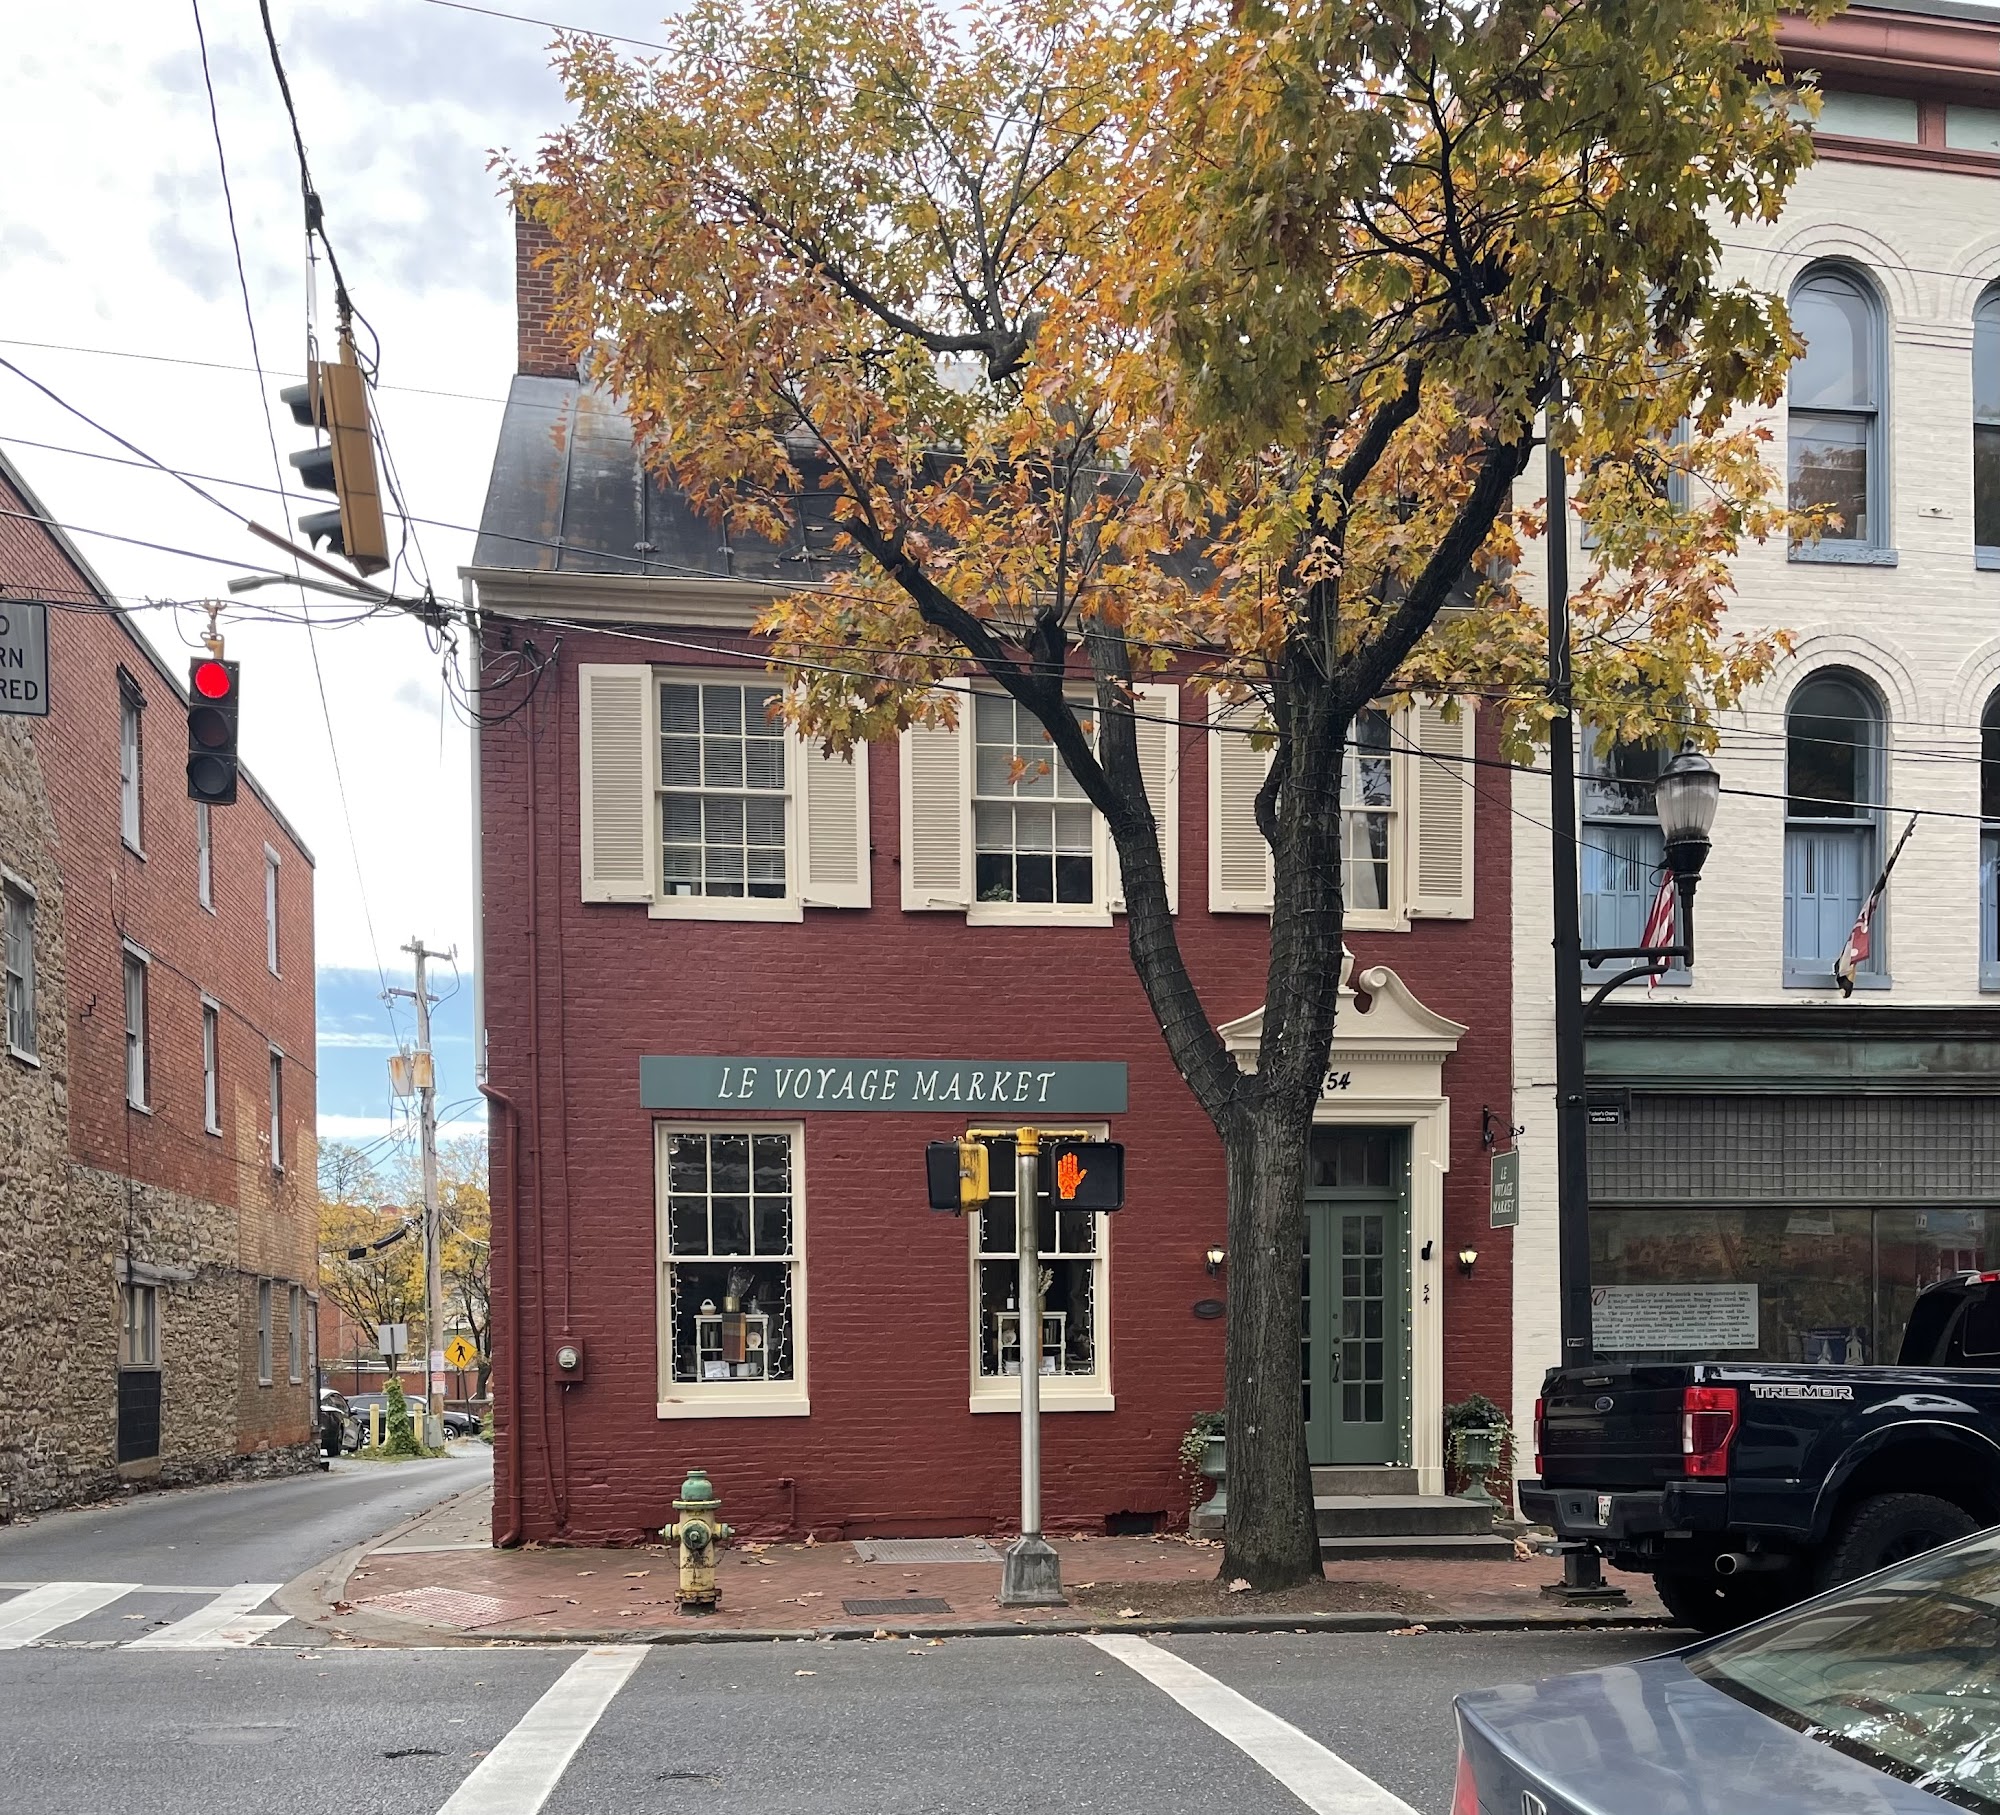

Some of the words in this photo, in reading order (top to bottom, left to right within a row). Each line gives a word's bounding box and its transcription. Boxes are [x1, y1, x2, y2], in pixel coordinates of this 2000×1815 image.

[717, 1067, 758, 1099] LE
[774, 1068, 899, 1101] VOYAGE
[911, 1070, 1056, 1102] MARKET
[1326, 1071, 1351, 1090] 54
[1500, 1166, 1508, 1180] LE
[1492, 1199, 1516, 1214] MARKET
[1749, 1383, 1855, 1400] TREMOR
